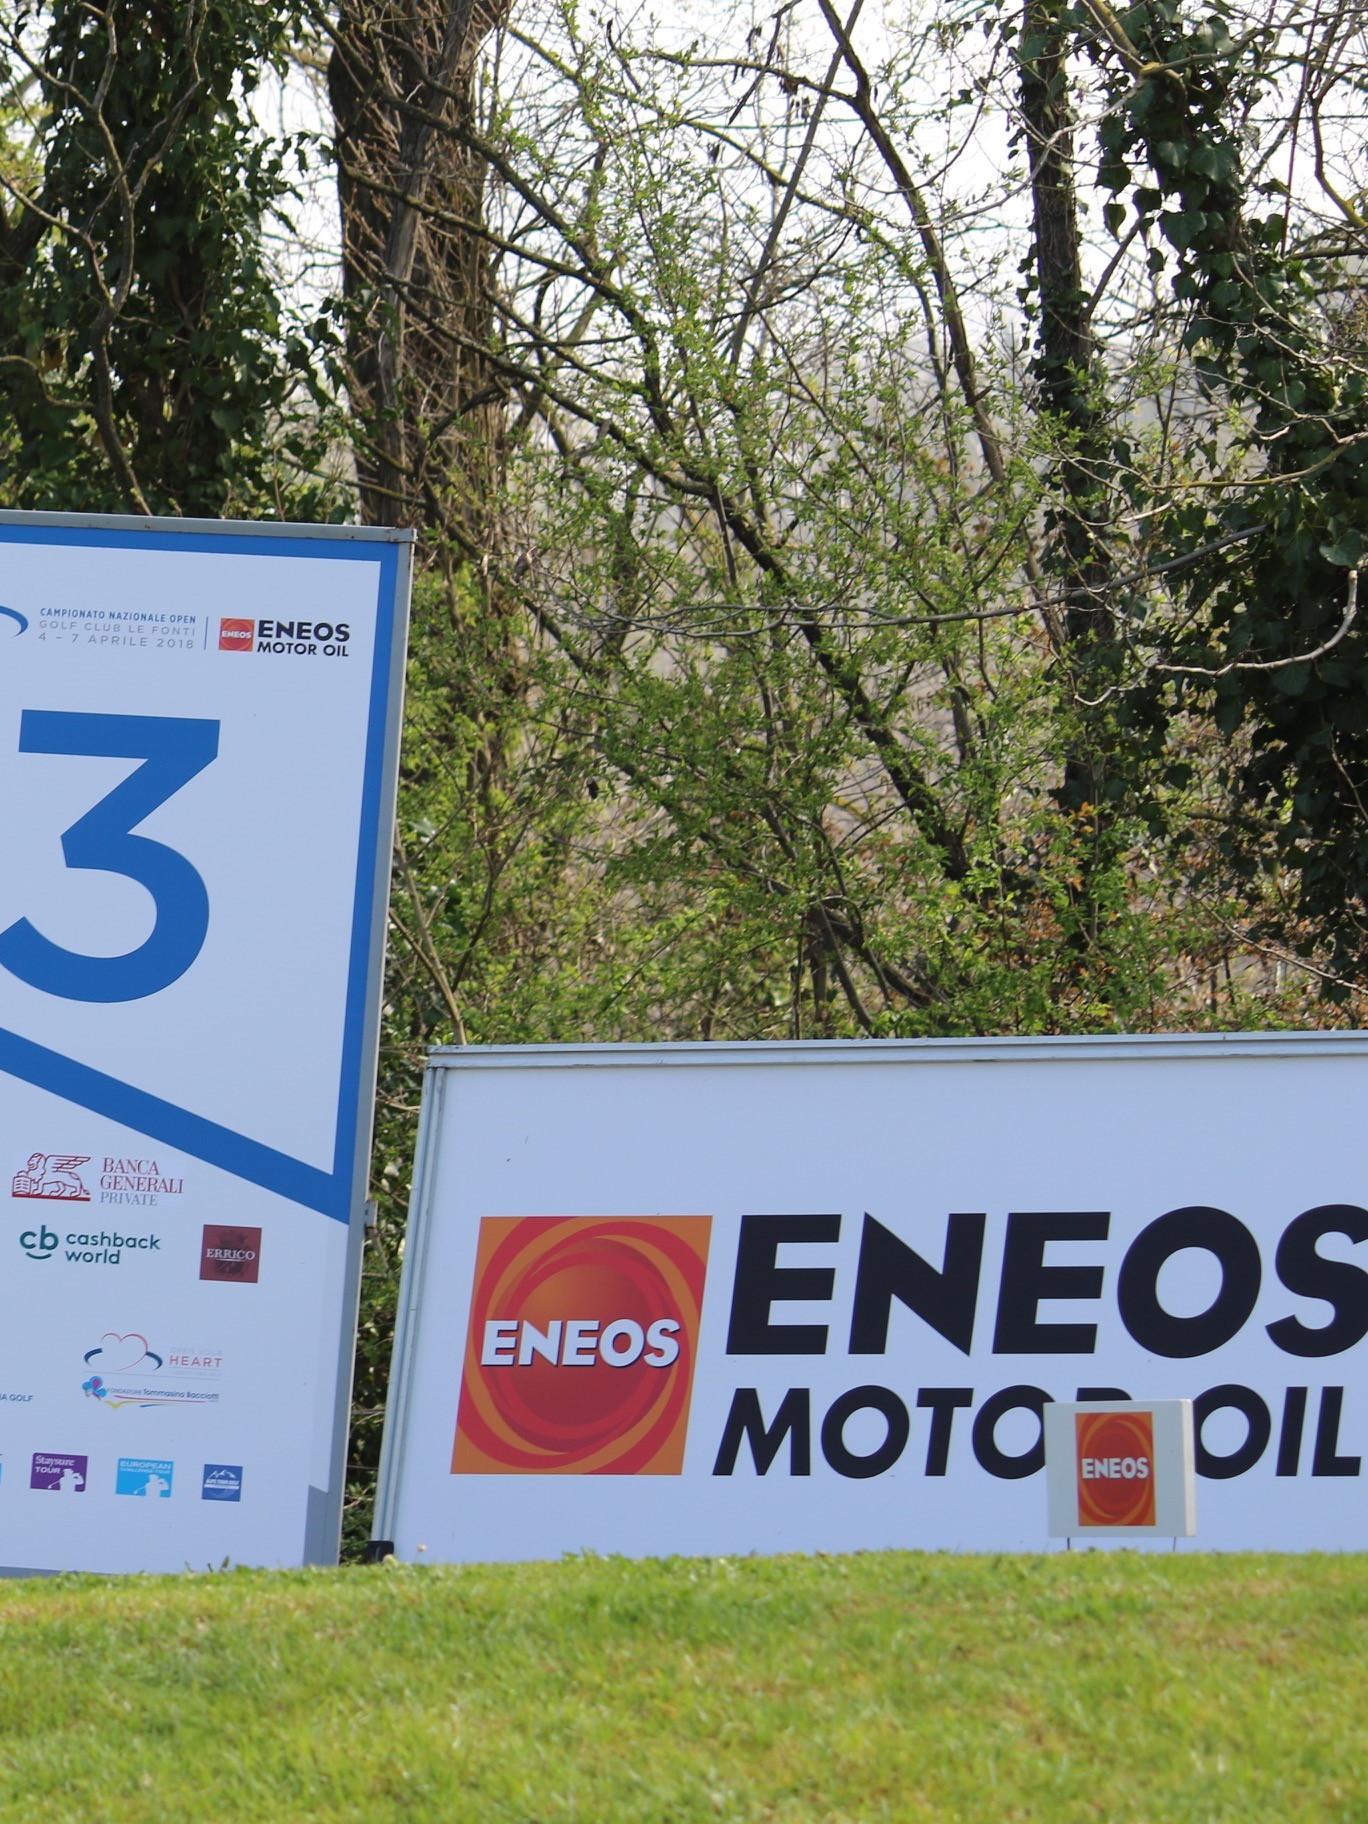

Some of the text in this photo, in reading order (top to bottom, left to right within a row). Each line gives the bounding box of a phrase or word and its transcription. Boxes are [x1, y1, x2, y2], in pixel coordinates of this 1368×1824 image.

[40, 608, 196, 624] CAMPIONATO NAZIONALE OPEN
[39, 620, 196, 636] GOLF CLUB LE FONTI
[221, 630, 252, 639] ENEOS
[257, 619, 350, 642] ENEOS
[38, 632, 47, 641] 4
[71, 633, 79, 643] 7
[87, 635, 148, 647] APRILE
[156, 637, 194, 649] 2018
[257, 641, 349, 657] MOTOR OIL
[102, 1157, 161, 1176] BANCA
[100, 1175, 184, 1194] GENERALI
[99, 1192, 158, 1206] PRIVATE
[19, 1225, 59, 1251] cb
[65, 1232, 161, 1250] cashback
[64, 1250, 121, 1265] world
[205, 1248, 256, 1261] ERRICO
[725, 1204, 1368, 1359] ENEOS
[480, 1318, 681, 1368] ENEOS
[169, 1355, 222, 1368] HEART
[9, 1393, 33, 1402] GOLF
[712, 1383, 1363, 1480] MOTO OIL
[35, 1455, 75, 1467] Staysure
[120, 1460, 172, 1470] EUROPEAN
[1082, 1457, 1149, 1479] ENEOS
[35, 1466, 61, 1474] TOUR
